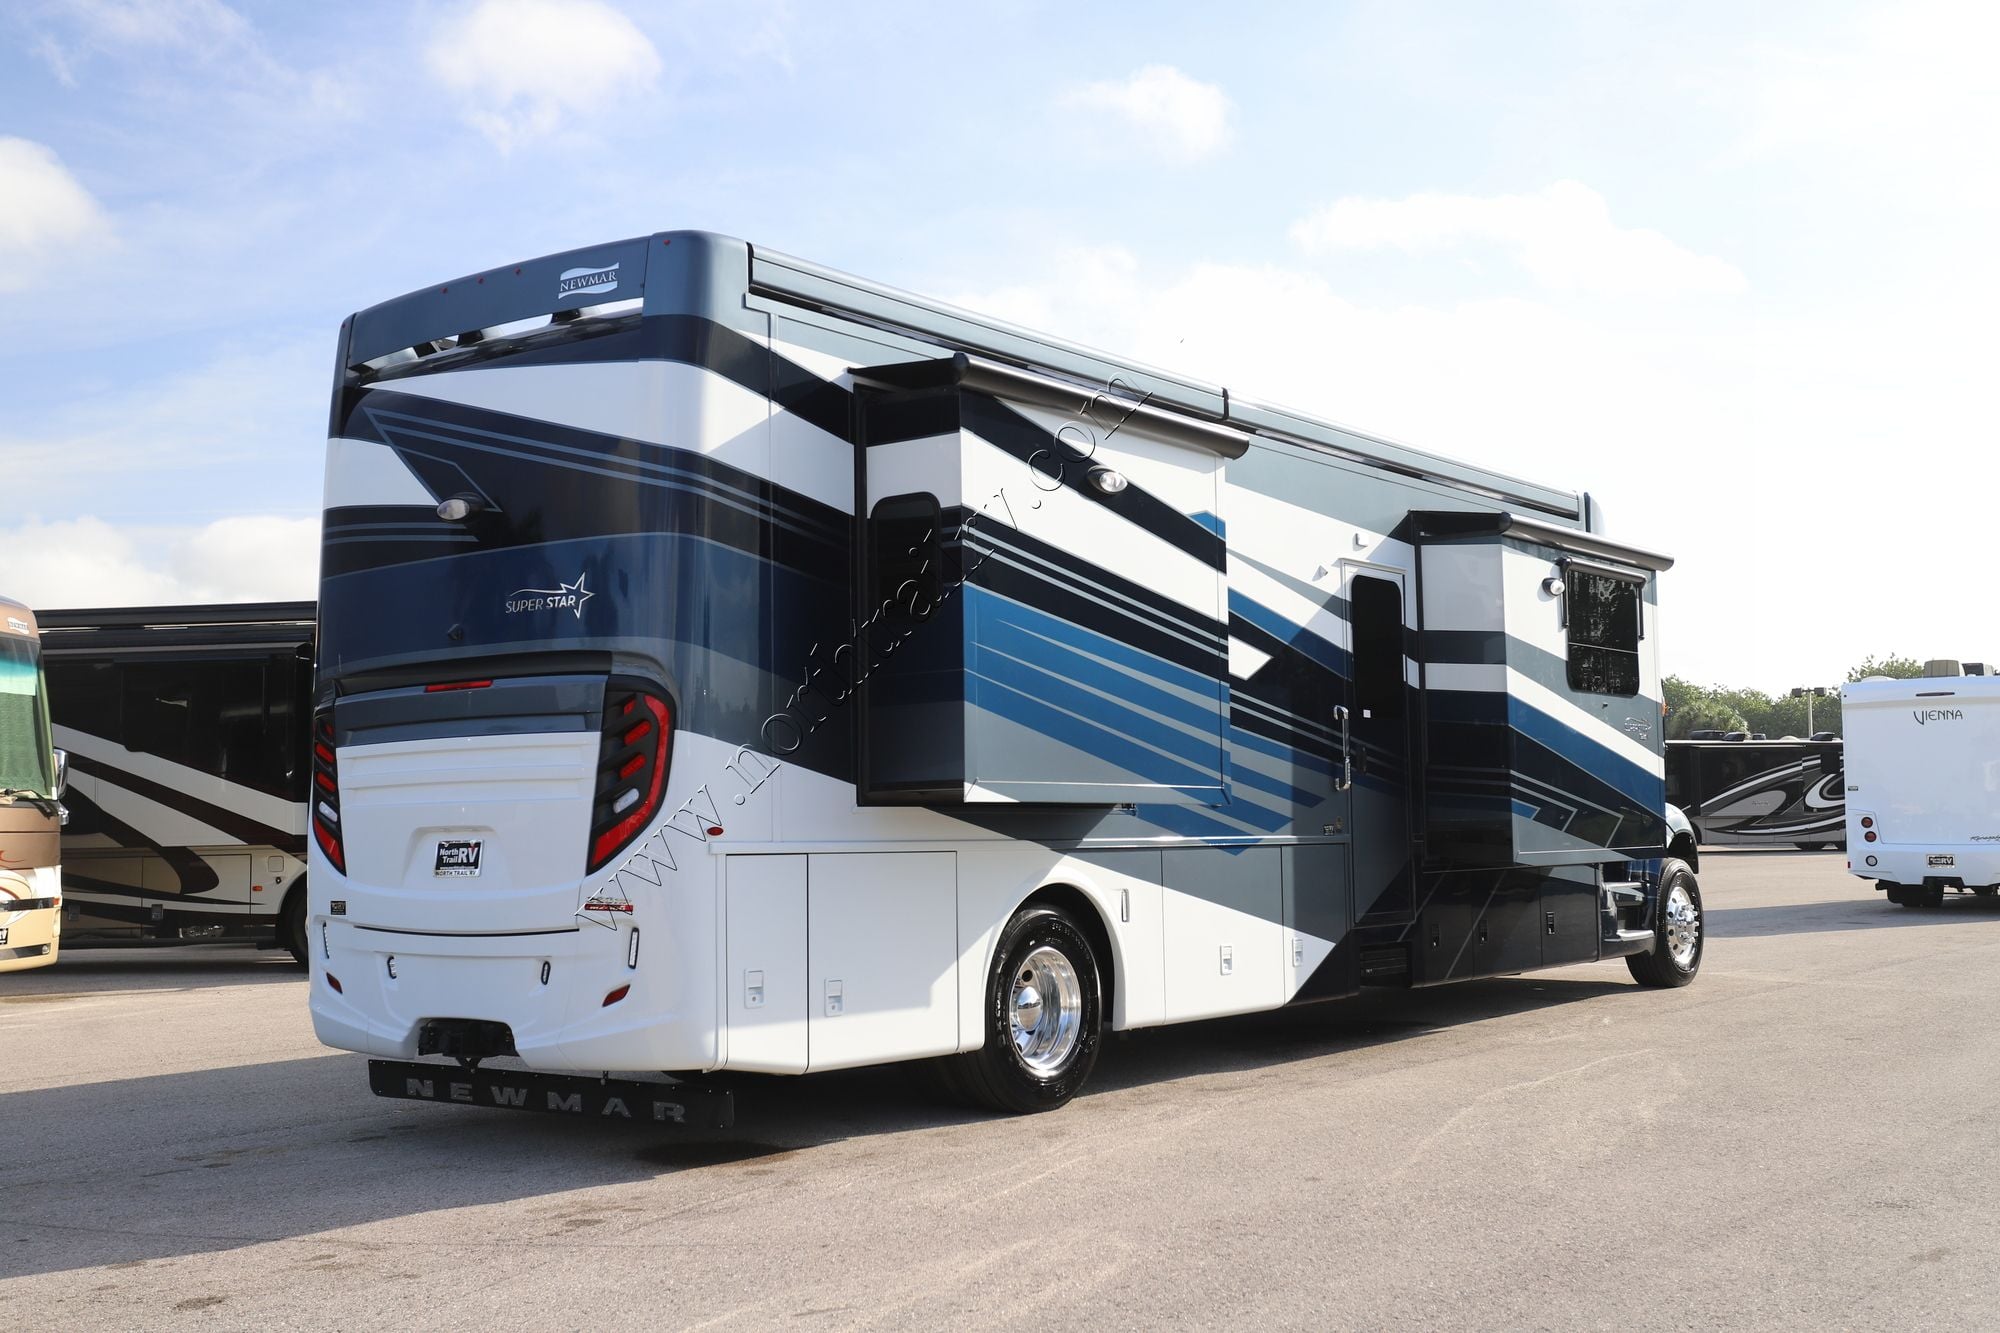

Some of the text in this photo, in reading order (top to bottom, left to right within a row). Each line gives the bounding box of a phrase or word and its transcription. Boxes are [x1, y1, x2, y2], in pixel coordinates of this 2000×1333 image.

[560, 271, 617, 292] NEWMAR
[505, 595, 576, 614] SUPER STAR
[1913, 709, 1963, 726] VIENNA
[439, 847, 479, 863] North RV
[442, 856, 458, 864] Trail
[405, 1077, 685, 1123] NEWMAR
